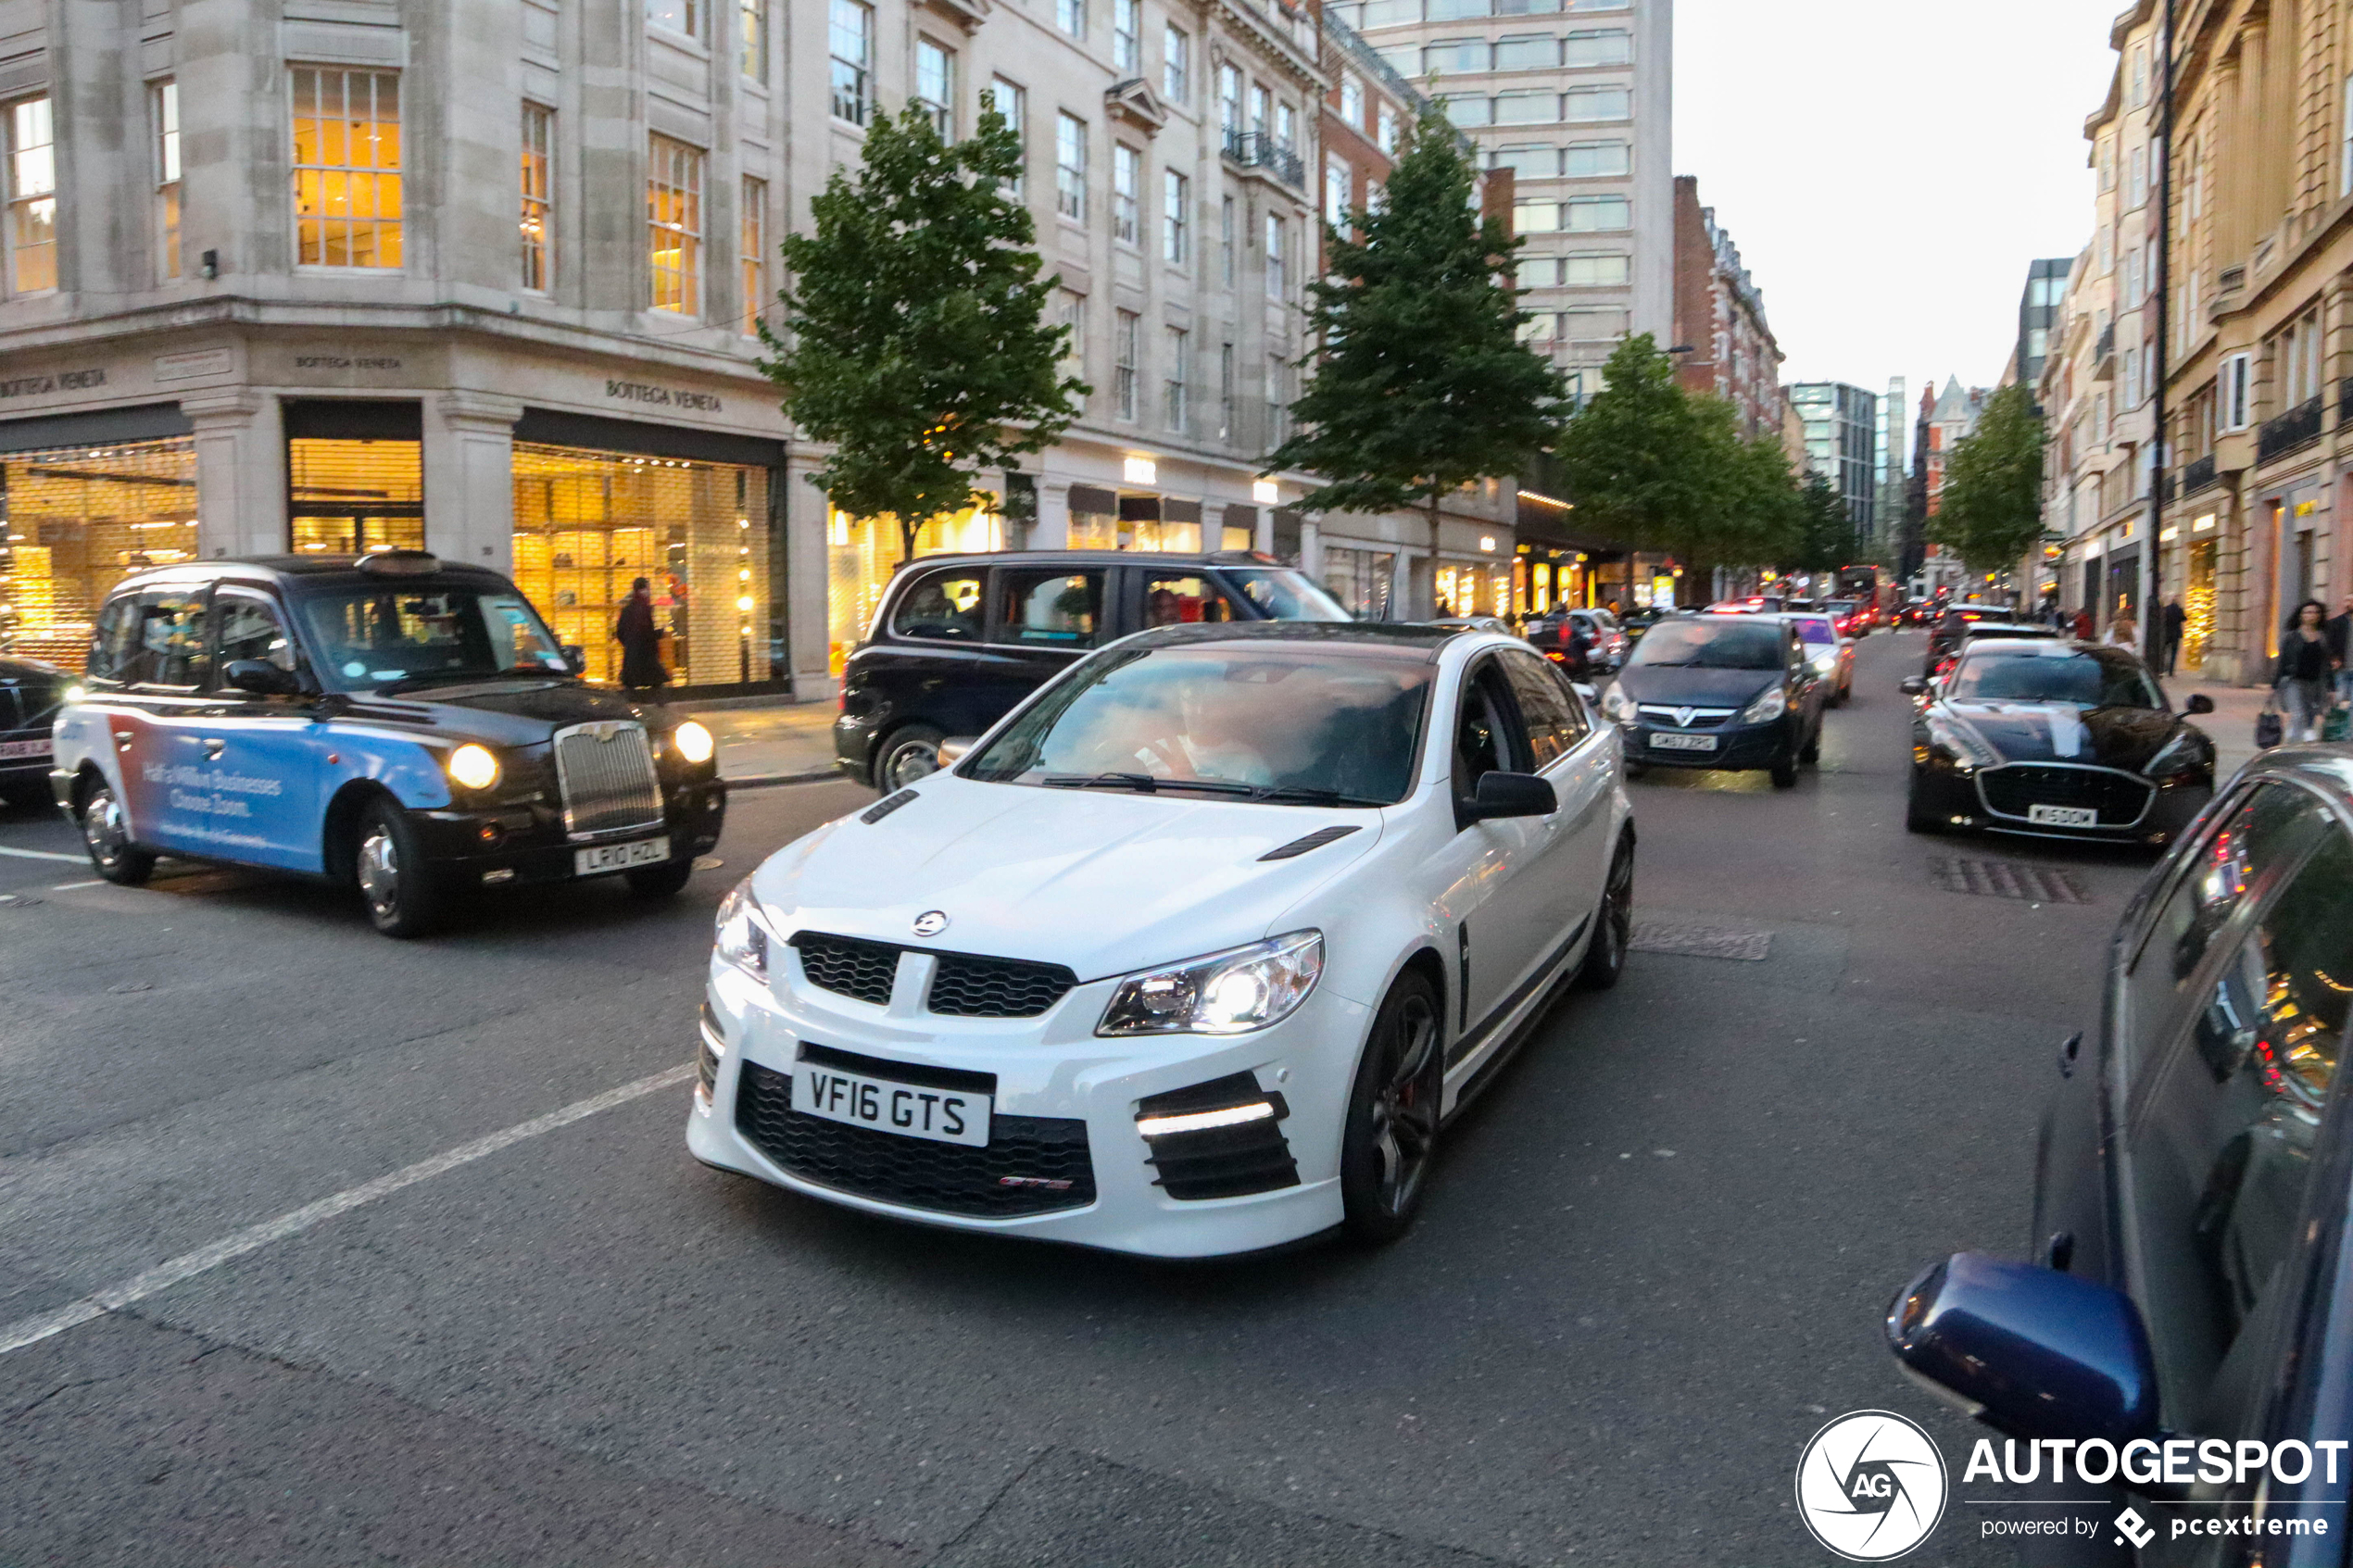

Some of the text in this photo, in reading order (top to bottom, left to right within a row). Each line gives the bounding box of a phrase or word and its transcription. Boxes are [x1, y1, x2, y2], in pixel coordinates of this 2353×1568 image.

[296, 357, 401, 370] BOTTEGA VENETA
[57, 369, 107, 391] VENETA
[606, 380, 723, 413] BOTTEGA VENETA
[212, 768, 283, 797] Businesses
[586, 841, 662, 869] LR10 HZL
[810, 1071, 965, 1135] VF16 GTS
[1000, 1176, 1074, 1189] GTS
